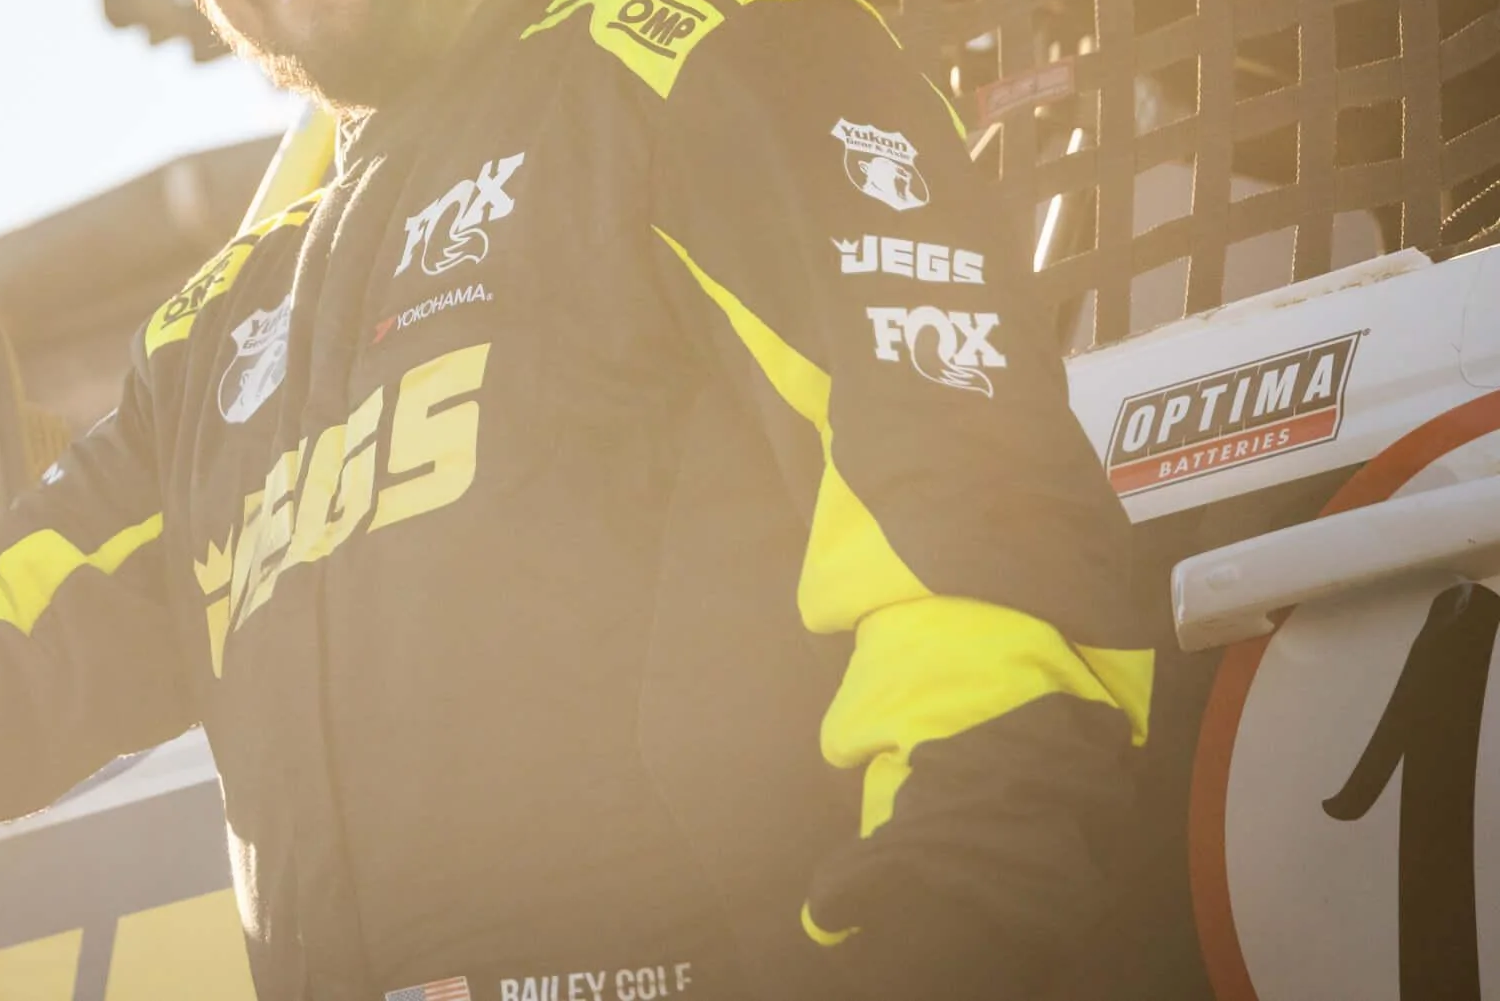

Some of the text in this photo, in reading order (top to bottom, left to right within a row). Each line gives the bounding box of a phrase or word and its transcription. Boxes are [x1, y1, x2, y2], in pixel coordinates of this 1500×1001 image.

[841, 124, 908, 152] Yukon
[393, 152, 524, 277] FOX
[830, 234, 986, 285] JEGS
[396, 283, 486, 331] YOKOHAMA
[866, 305, 1007, 398] FOX
[1122, 353, 1336, 453] OPTIMA
[1158, 428, 1291, 478] BATTERIES
[194, 342, 491, 679] JEGS
[500, 971, 606, 1001] BAILEY
